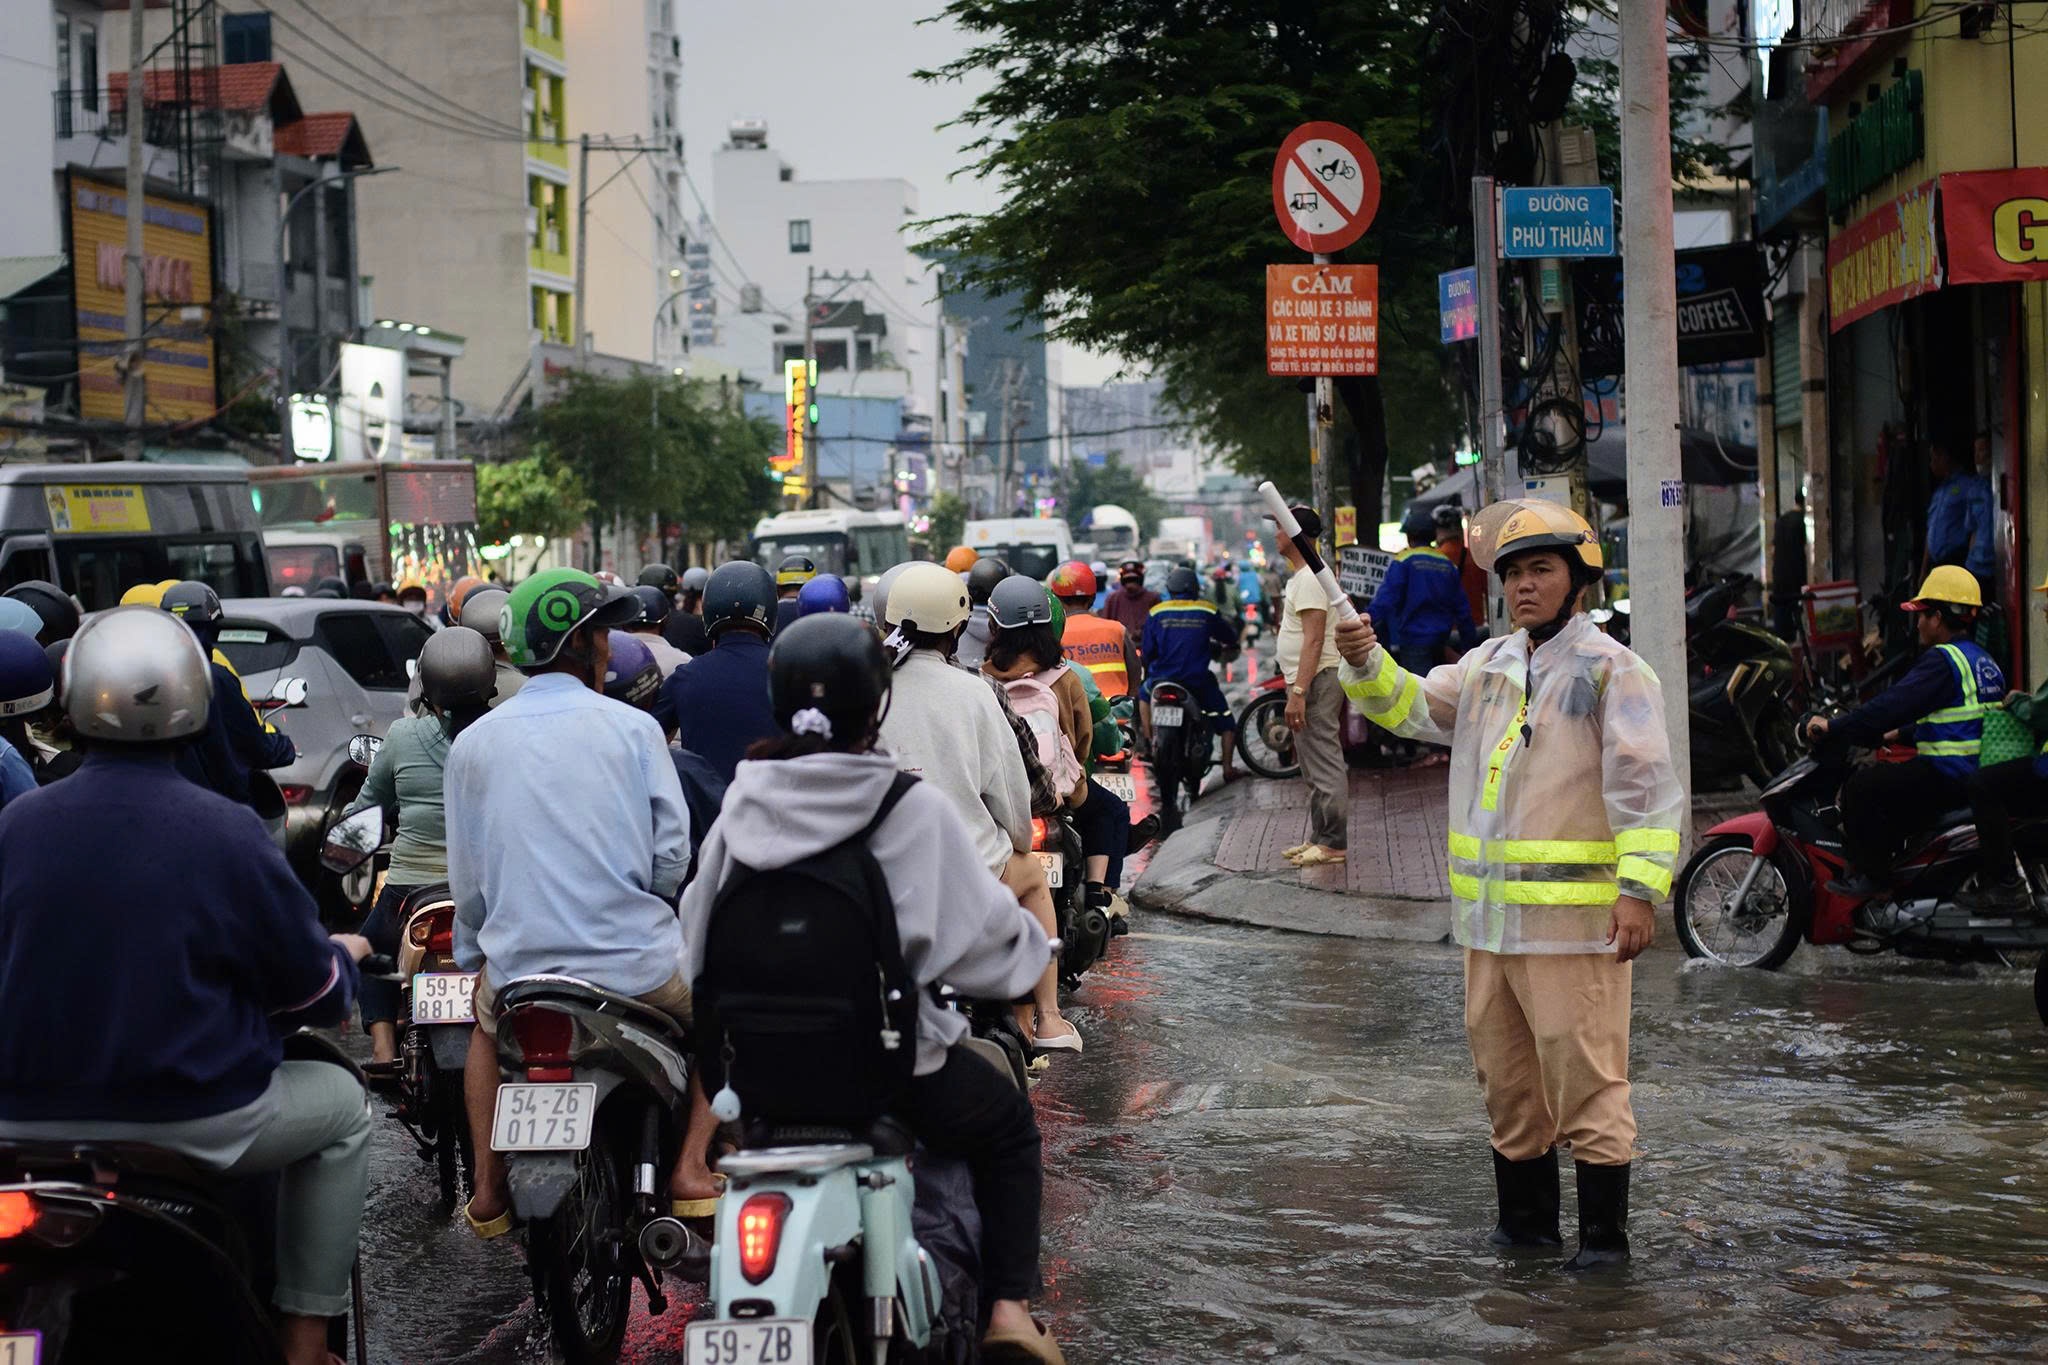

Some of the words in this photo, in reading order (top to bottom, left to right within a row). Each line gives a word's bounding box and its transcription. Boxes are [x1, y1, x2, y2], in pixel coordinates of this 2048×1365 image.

[1528, 192, 1590, 213] ĐƯỜNG
[1512, 221, 1545, 248] PHÚ
[1550, 220, 1604, 252] THUẬN
[1291, 267, 1353, 295] CẤM
[1272, 296, 1293, 318] CÁC
[1295, 300, 1318, 321] LOẠI
[1320, 301, 1333, 318] XE
[1335, 301, 1342, 318] 3
[1344, 296, 1373, 318] BÁNH
[1677, 298, 1740, 334] COFFEE
[1269, 320, 1283, 342] VÀ
[1285, 325, 1299, 342] XE
[1300, 320, 1321, 343] THÔ
[1322, 322, 1338, 343] SƠ
[1338, 325, 1346, 343] 4
[1348, 321, 1376, 343] BÁNH
[1361, 551, 1390, 567] THUÊ
[1370, 566, 1385, 579] TR
[418, 998, 473, 1020] 881.3
[510, 1087, 580, 1115] 54-Z6
[507, 1117, 577, 1146] 0175
